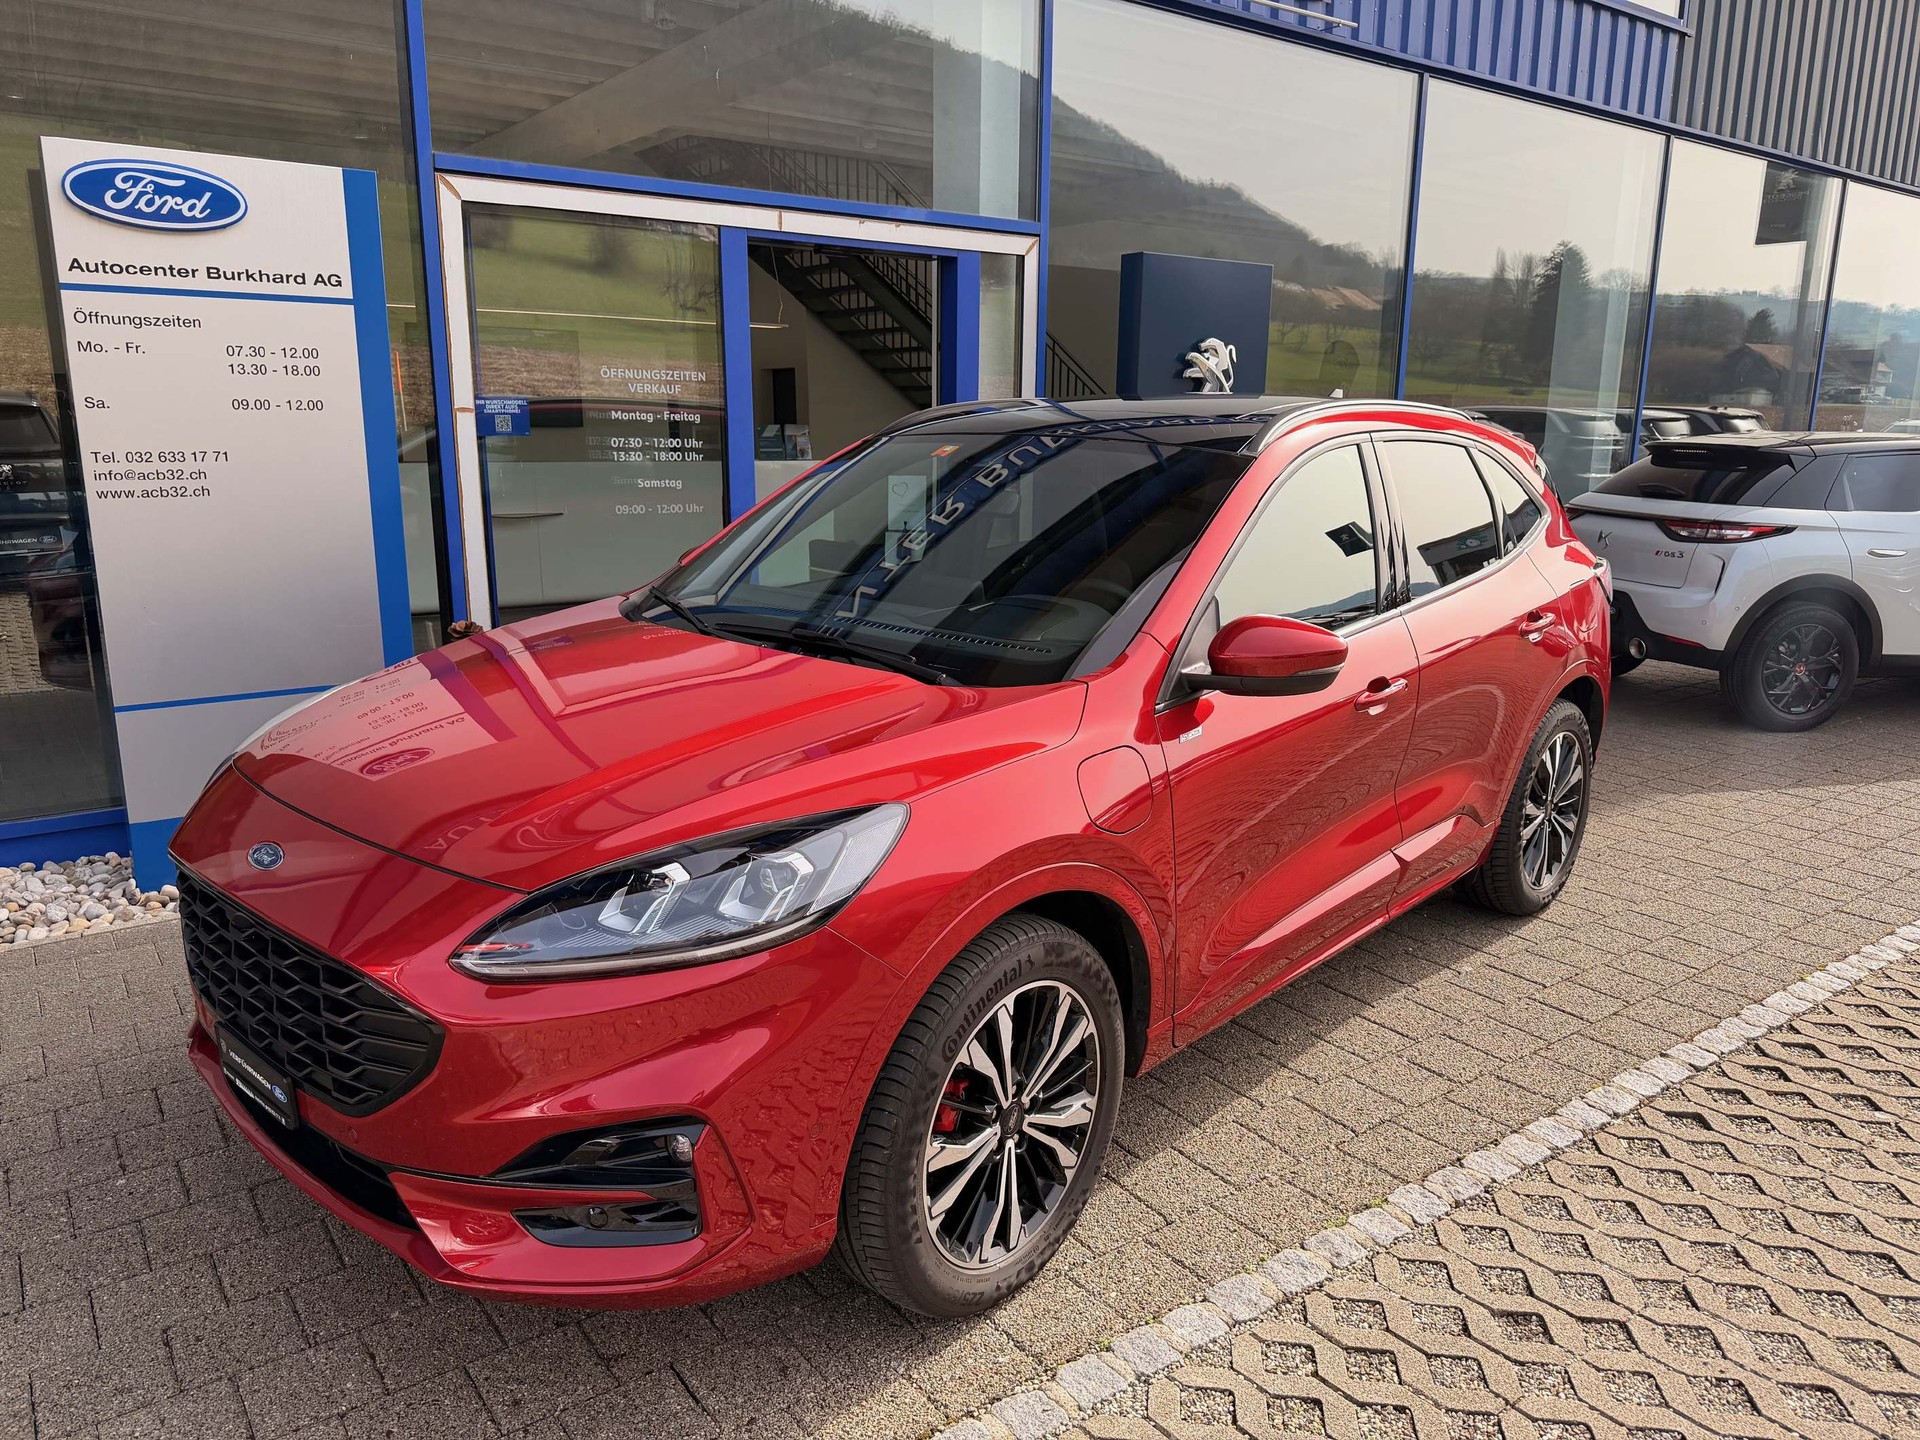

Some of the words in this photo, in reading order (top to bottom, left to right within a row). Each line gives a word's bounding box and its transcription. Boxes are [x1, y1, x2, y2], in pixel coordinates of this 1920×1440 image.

[104, 171, 212, 219] Ford
[68, 258, 199, 279] Autocenter
[206, 266, 306, 286] Burkhard
[313, 273, 343, 288] AG
[73, 308, 202, 329] Öffnungszeiten
[77, 340, 108, 353] Mo.
[126, 342, 146, 354] Fr.
[226, 345, 266, 358] 07.30
[281, 347, 319, 359] 12.00
[228, 363, 267, 376] 13.30
[282, 364, 321, 377] 18.00
[600, 365, 706, 381] ÖFFNUNGSZEITEN
[628, 383, 682, 394] VERKAUF
[84, 397, 110, 409] Sa.
[232, 399, 270, 411] 09.00
[286, 399, 324, 411] 12.00
[611, 411, 653, 423] Montag
[663, 411, 701, 423] Freitag
[611, 437, 642, 448] 07:30
[653, 438, 682, 448] 12:00
[684, 438, 703, 448] Uhr
[91, 451, 120, 463] Tel.
[125, 451, 154, 463] 032
[158, 451, 186, 463] 633
[191, 451, 207, 463] 17
[212, 451, 229, 463] 71
[612, 451, 642, 461] 13:30
[654, 451, 682, 461] 18:00
[684, 451, 703, 461] Uhr
[93, 469, 207, 482] info@acb32.ch
[637, 478, 682, 489] Samstag
[96, 486, 211, 499] www.acb32.ch
[615, 505, 645, 515] 09:00
[657, 504, 683, 514] 12:00
[686, 504, 704, 513] Uhr
[941, 958, 1022, 1063] Continental
